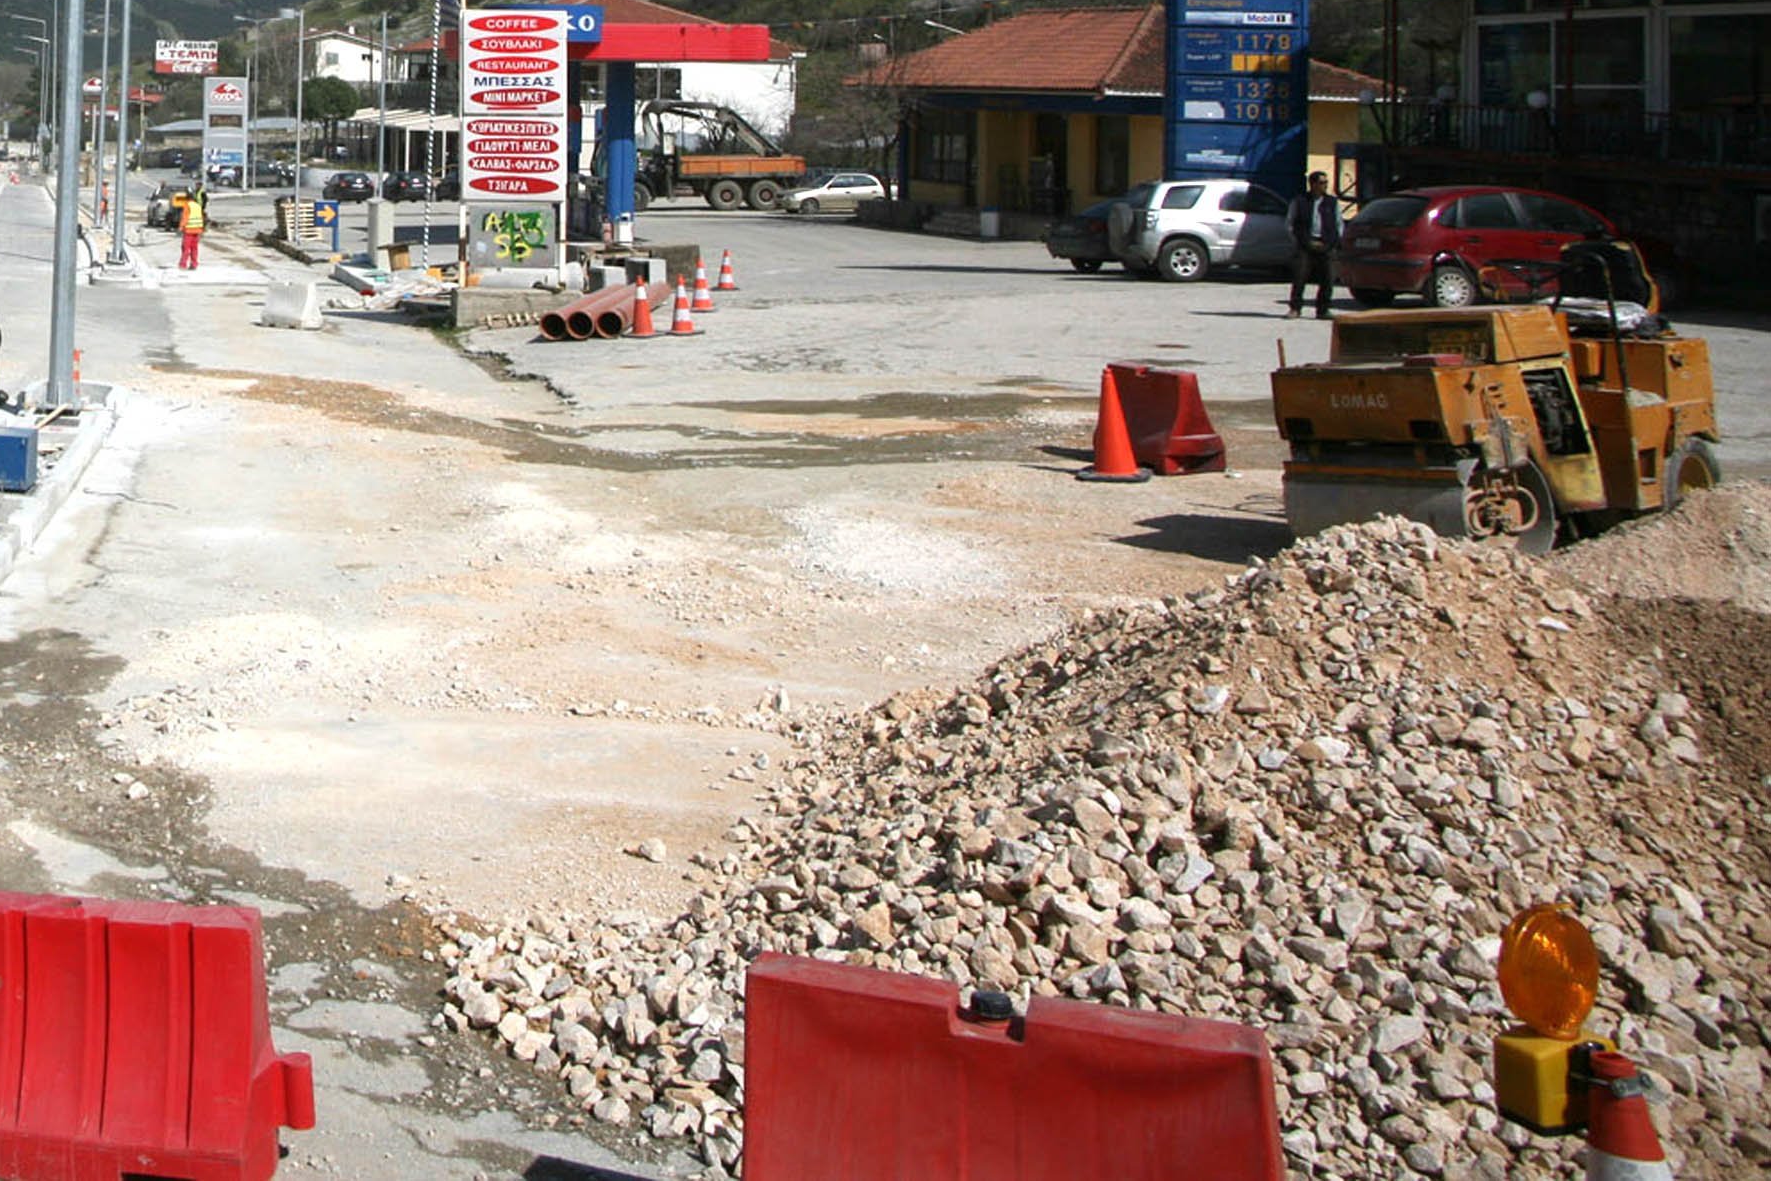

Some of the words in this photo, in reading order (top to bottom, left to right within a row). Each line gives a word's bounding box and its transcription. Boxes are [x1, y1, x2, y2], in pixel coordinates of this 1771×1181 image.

[486, 19, 538, 28] COFFEE
[567, 15, 595, 31] KO
[481, 39, 542, 49] ΣΟΥΒΛΑΚΙ
[477, 60, 549, 70] RESTAURANT
[474, 76, 554, 87] ΜΠΕΣΣΑΣ
